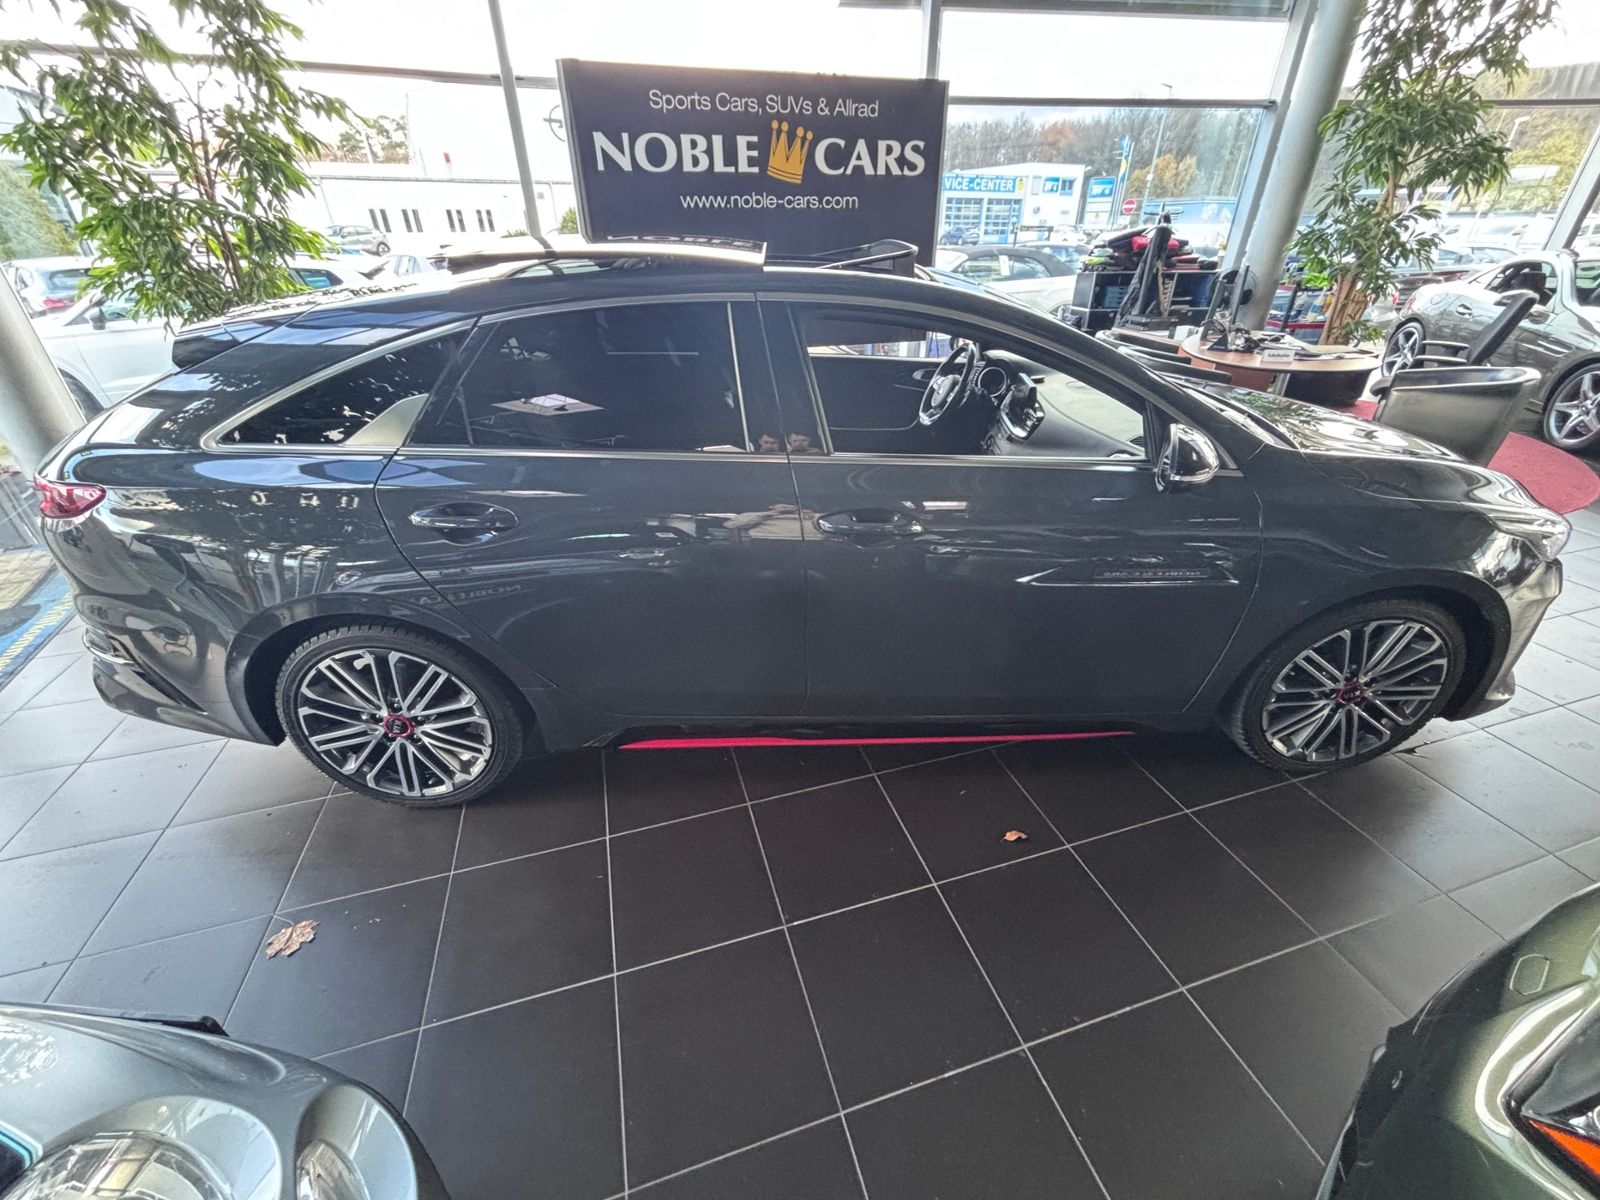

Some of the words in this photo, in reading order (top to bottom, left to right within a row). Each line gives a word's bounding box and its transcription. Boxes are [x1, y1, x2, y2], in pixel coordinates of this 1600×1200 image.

[648, 90, 711, 113] Sports
[716, 94, 763, 114] Cars,
[766, 96, 813, 115] SUVs
[818, 98, 831, 115] &
[834, 99, 879, 118] Allrad
[592, 131, 759, 174] NOBLE
[814, 138, 926, 176] CARS
[942, 177, 1013, 192] VICE-CENTER
[680, 193, 859, 210] www.noble-cars.com
